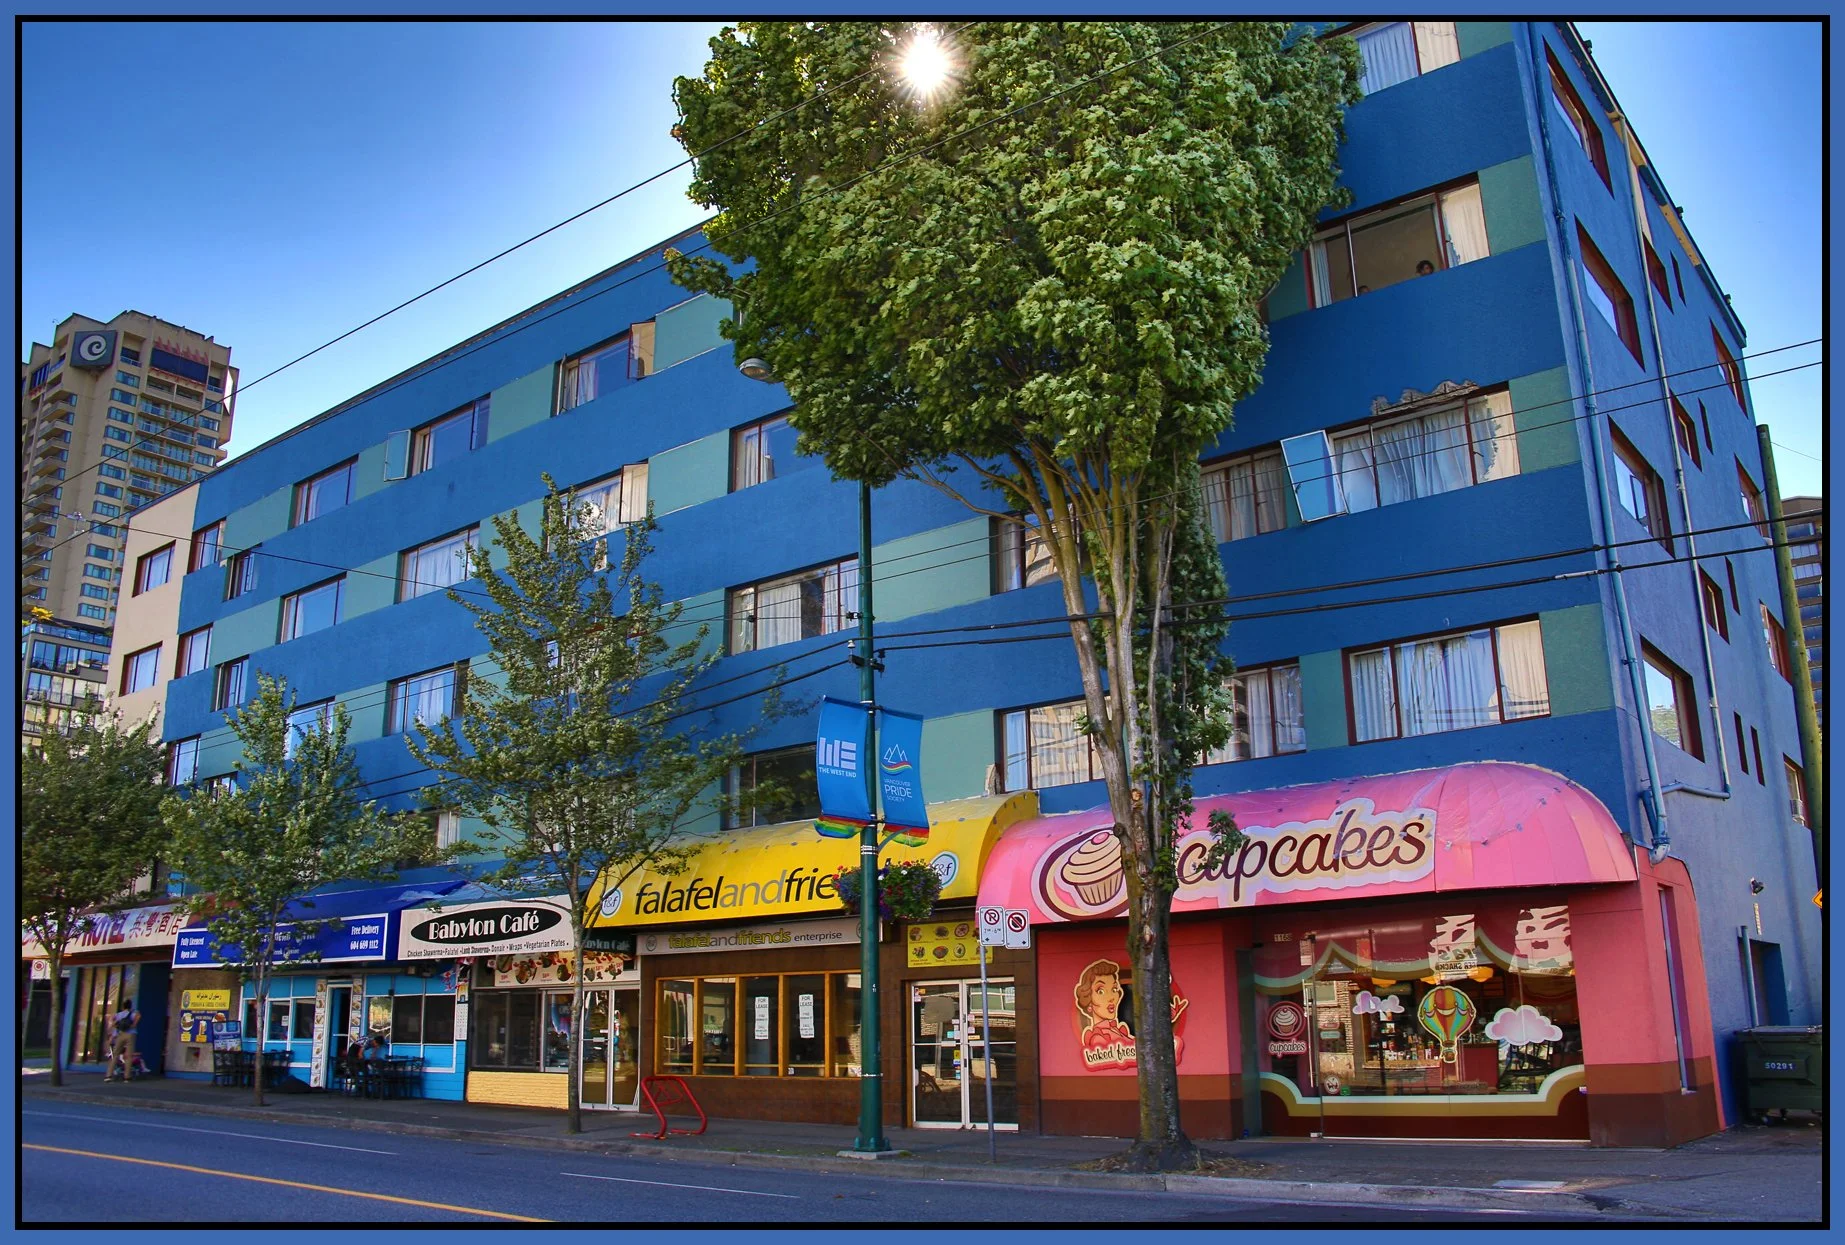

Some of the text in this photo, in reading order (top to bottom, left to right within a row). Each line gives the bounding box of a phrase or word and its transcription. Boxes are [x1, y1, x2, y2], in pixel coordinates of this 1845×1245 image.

[830, 768, 845, 776] WEST
[845, 770, 857, 778] END
[884, 779, 911, 787] VANCOUVER
[884, 784, 912, 798] PRIDE
[1178, 808, 1426, 902] cupcakes
[635, 857, 890, 915] falafelandfrie
[81, 912, 131, 946] HOTEL
[351, 925, 380, 936] Free Delivery
[428, 910, 540, 941] Babylon Café
[180, 937, 205, 947] Fully Licensed
[793, 930, 843, 942] enterprise
[350, 940, 359, 950] 604
[407, 950, 422, 958] Chicken
[491, 944, 505, 953] Donair
[509, 943, 523, 951] Wraps
[526, 940, 550, 950] Vegetarian
[551, 939, 566, 948] Plates
[180, 950, 198, 960] Open Late
[1085, 1043, 1137, 1063] baked fres
[1270, 1039, 1306, 1056] cupcakes
